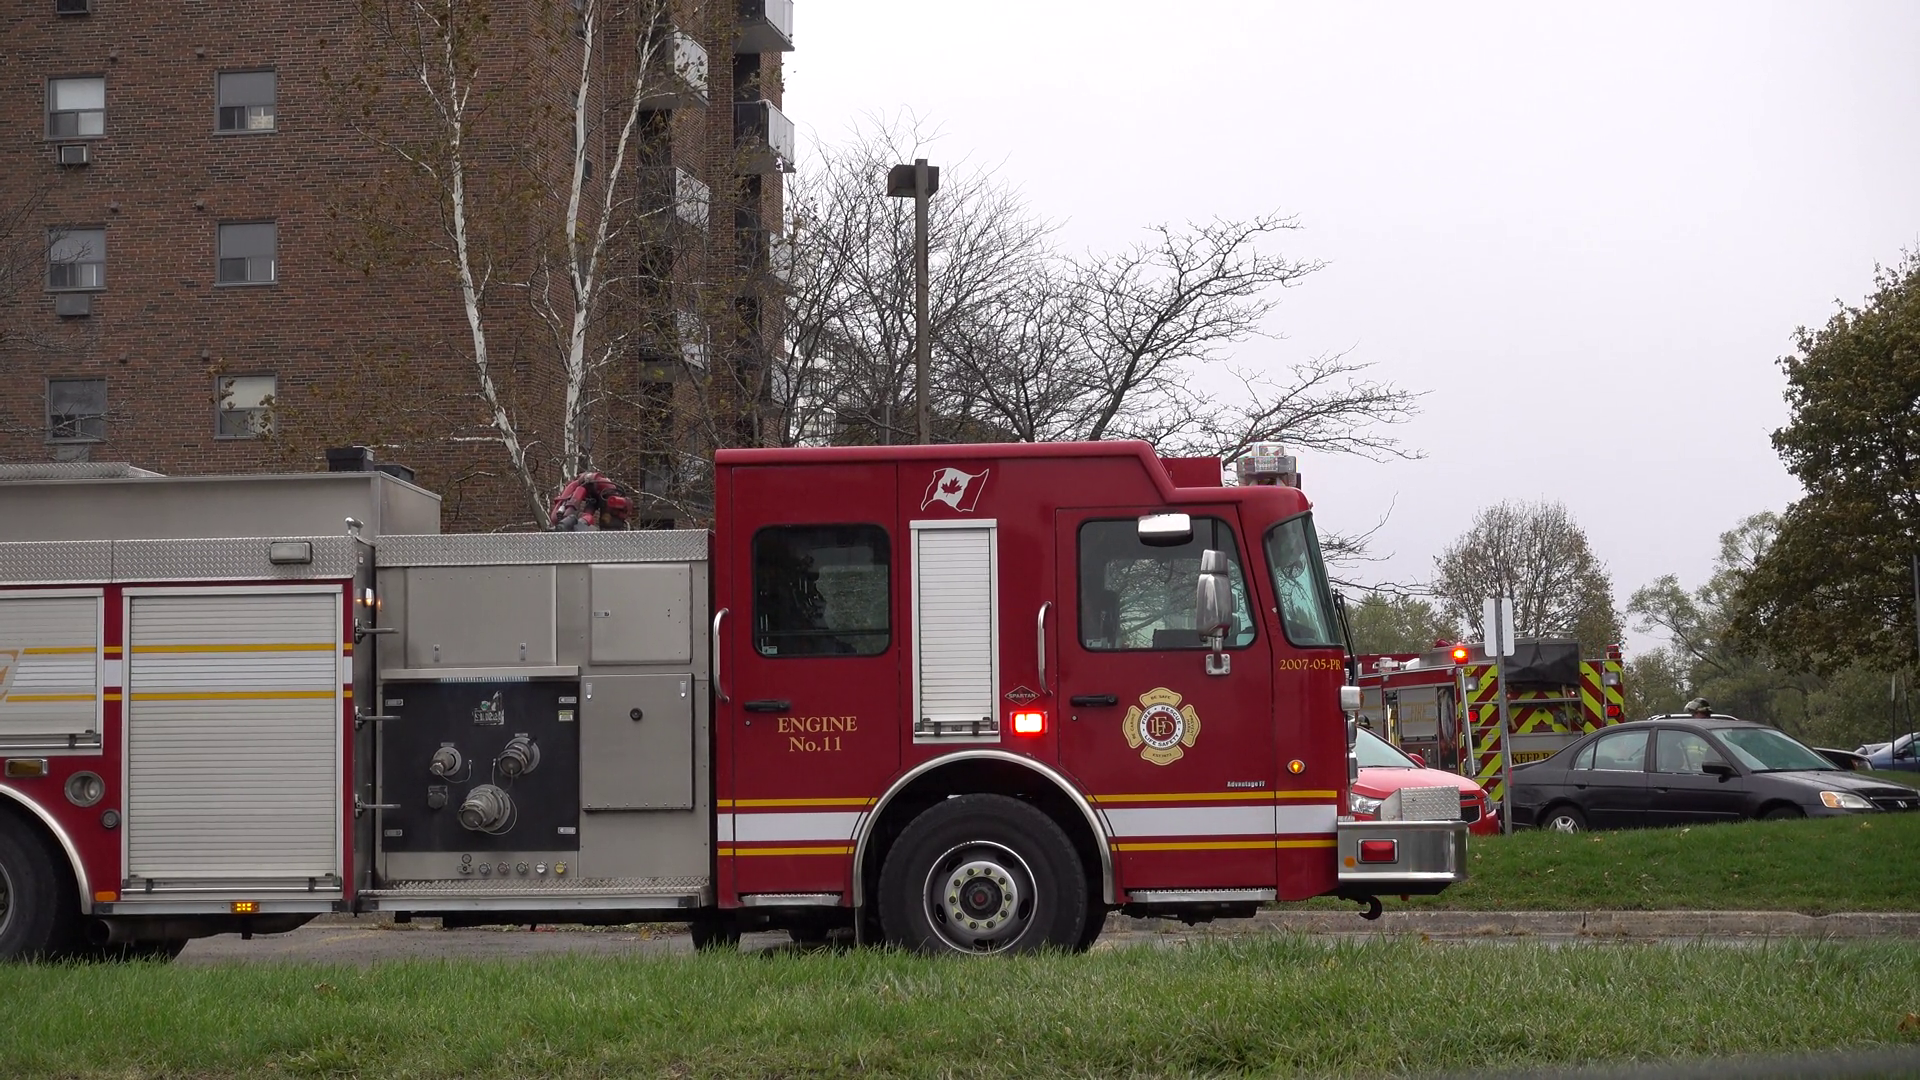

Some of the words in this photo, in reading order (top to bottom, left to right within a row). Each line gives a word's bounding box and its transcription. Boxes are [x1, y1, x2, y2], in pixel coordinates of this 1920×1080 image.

[1280, 658, 1341, 670] 2007-05-PR
[1141, 710, 1151, 724] FIRE
[1161, 706, 1181, 725] RESCUE
[777, 716, 857, 733] ENGINE
[789, 736, 842, 752] No.11
[1144, 734, 1157, 746] LIFE
[1158, 734, 1179, 747] SAFETY
[1512, 752, 1539, 764] KEEP
